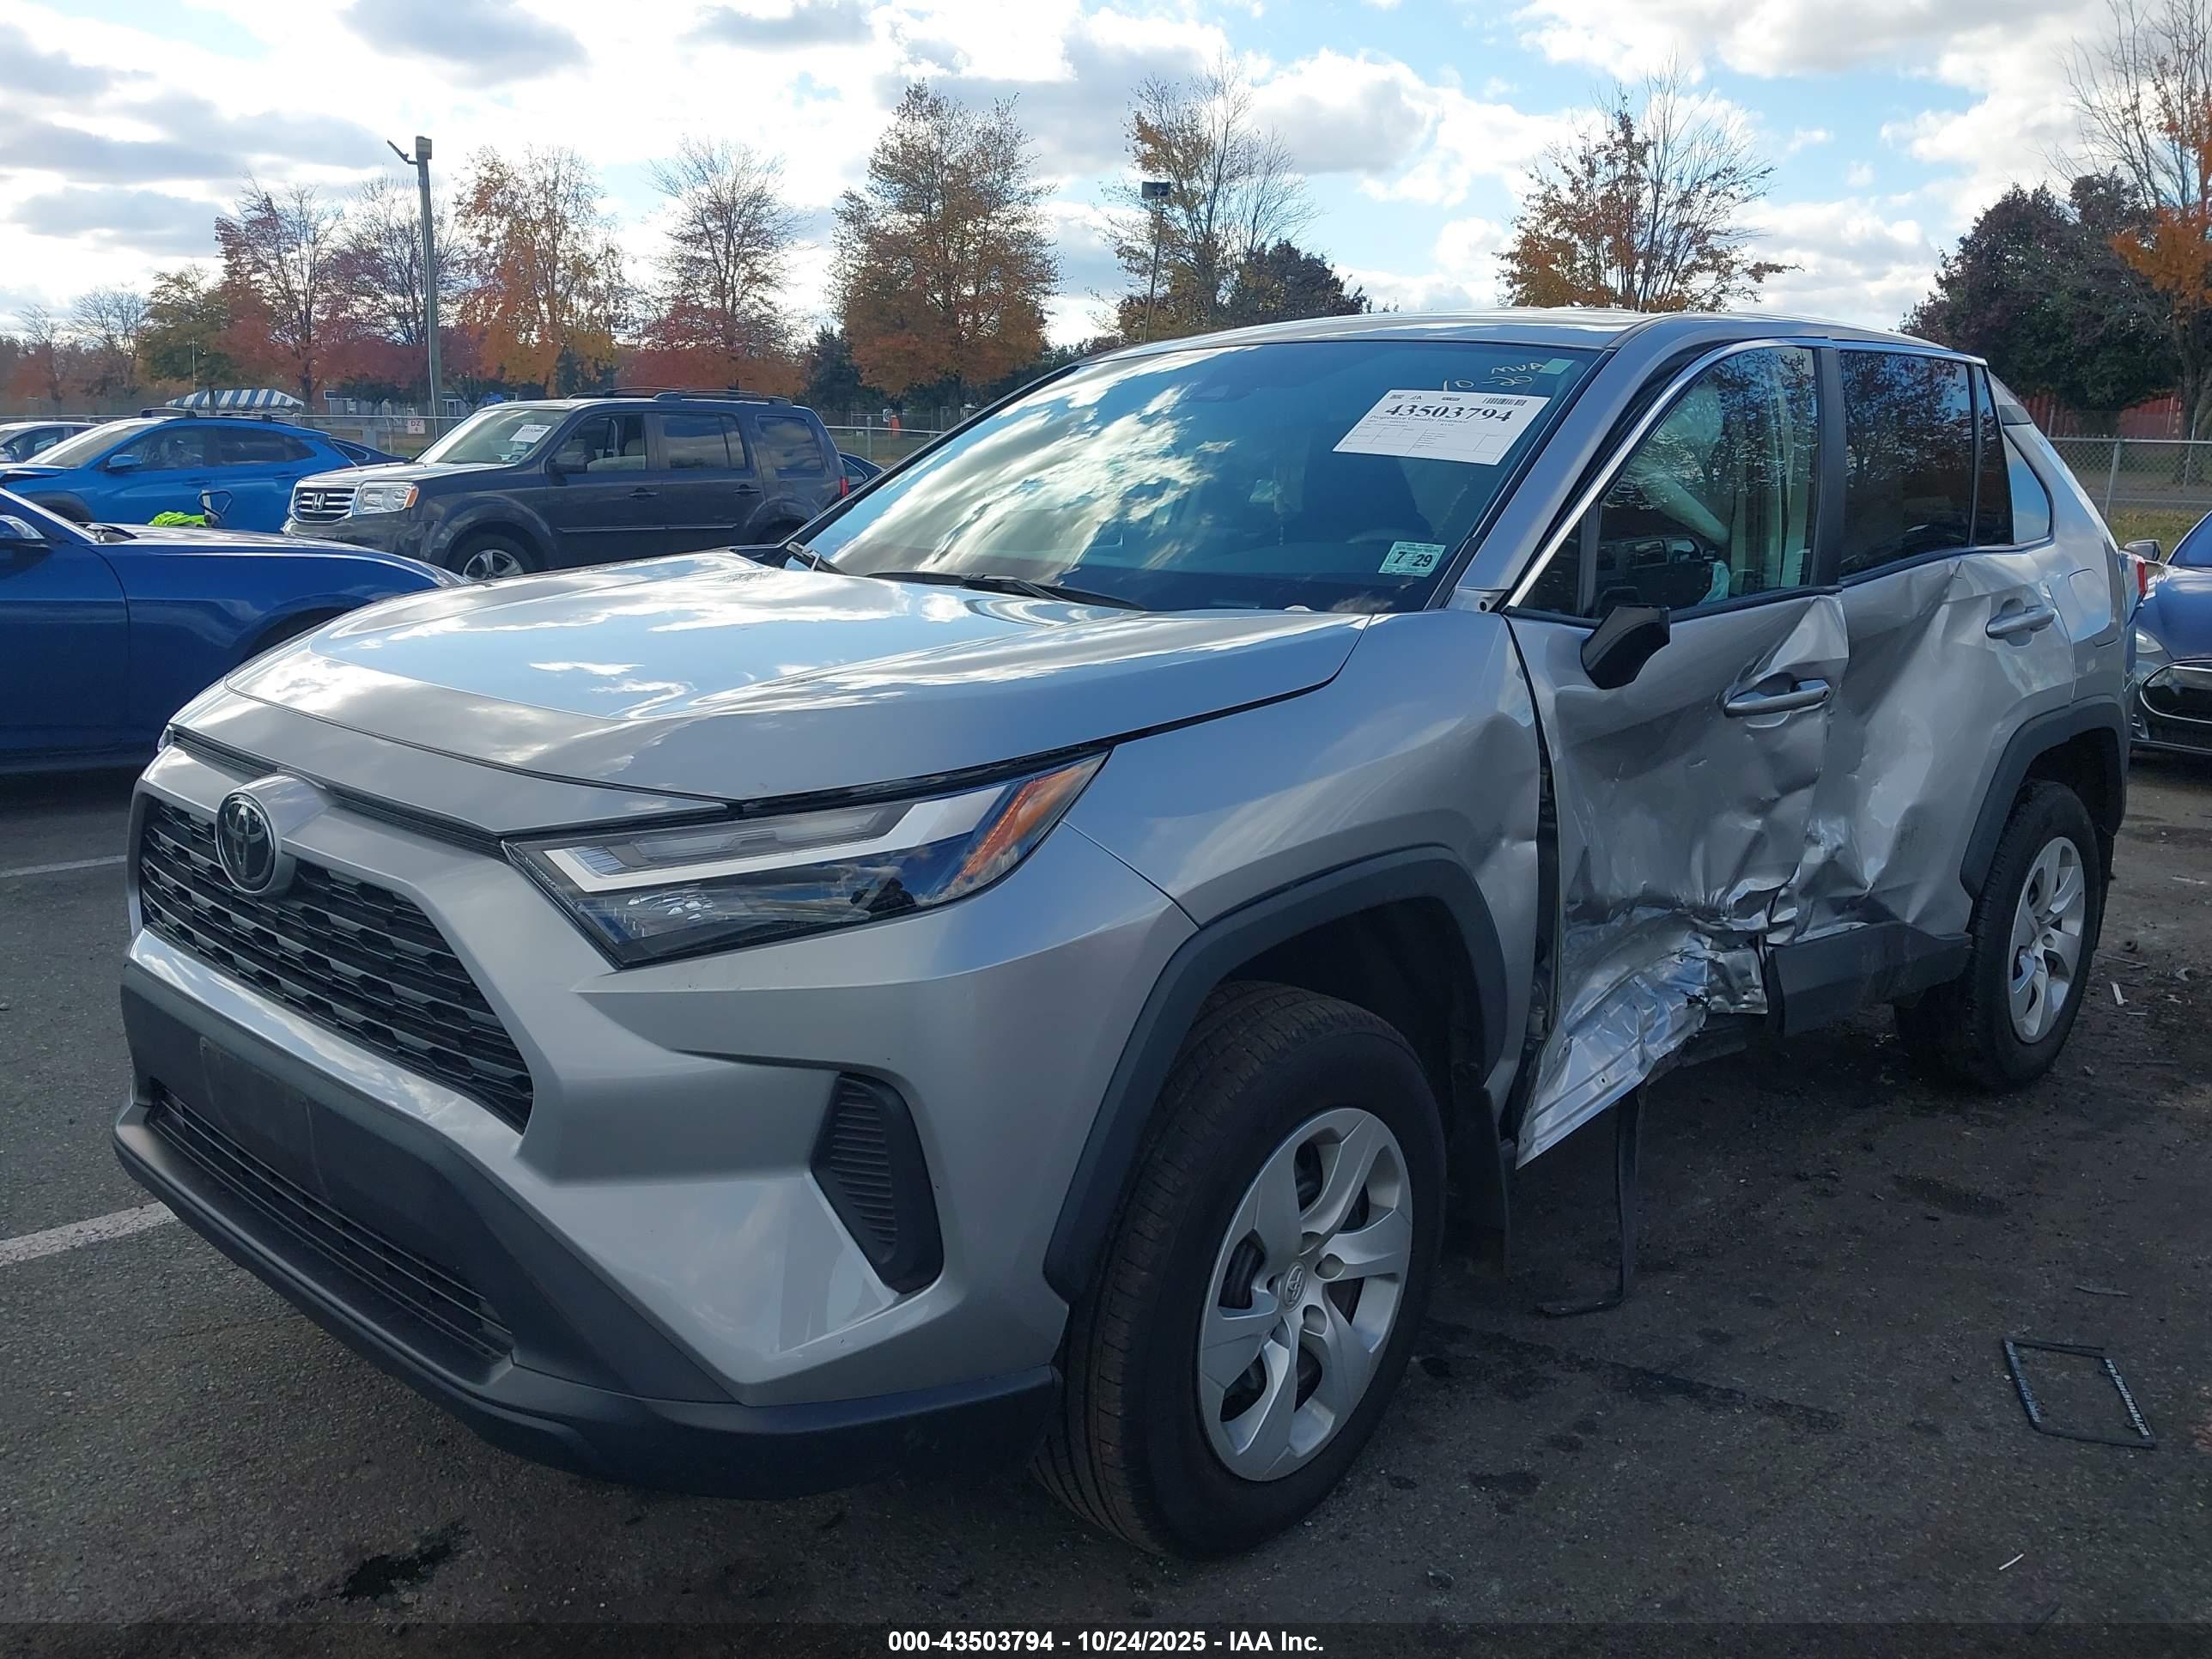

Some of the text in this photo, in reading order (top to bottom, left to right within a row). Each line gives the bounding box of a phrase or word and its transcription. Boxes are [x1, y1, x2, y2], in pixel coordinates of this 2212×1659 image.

[1385, 404, 1514, 422] 43503794
[1394, 551, 1433, 568] 7 29
